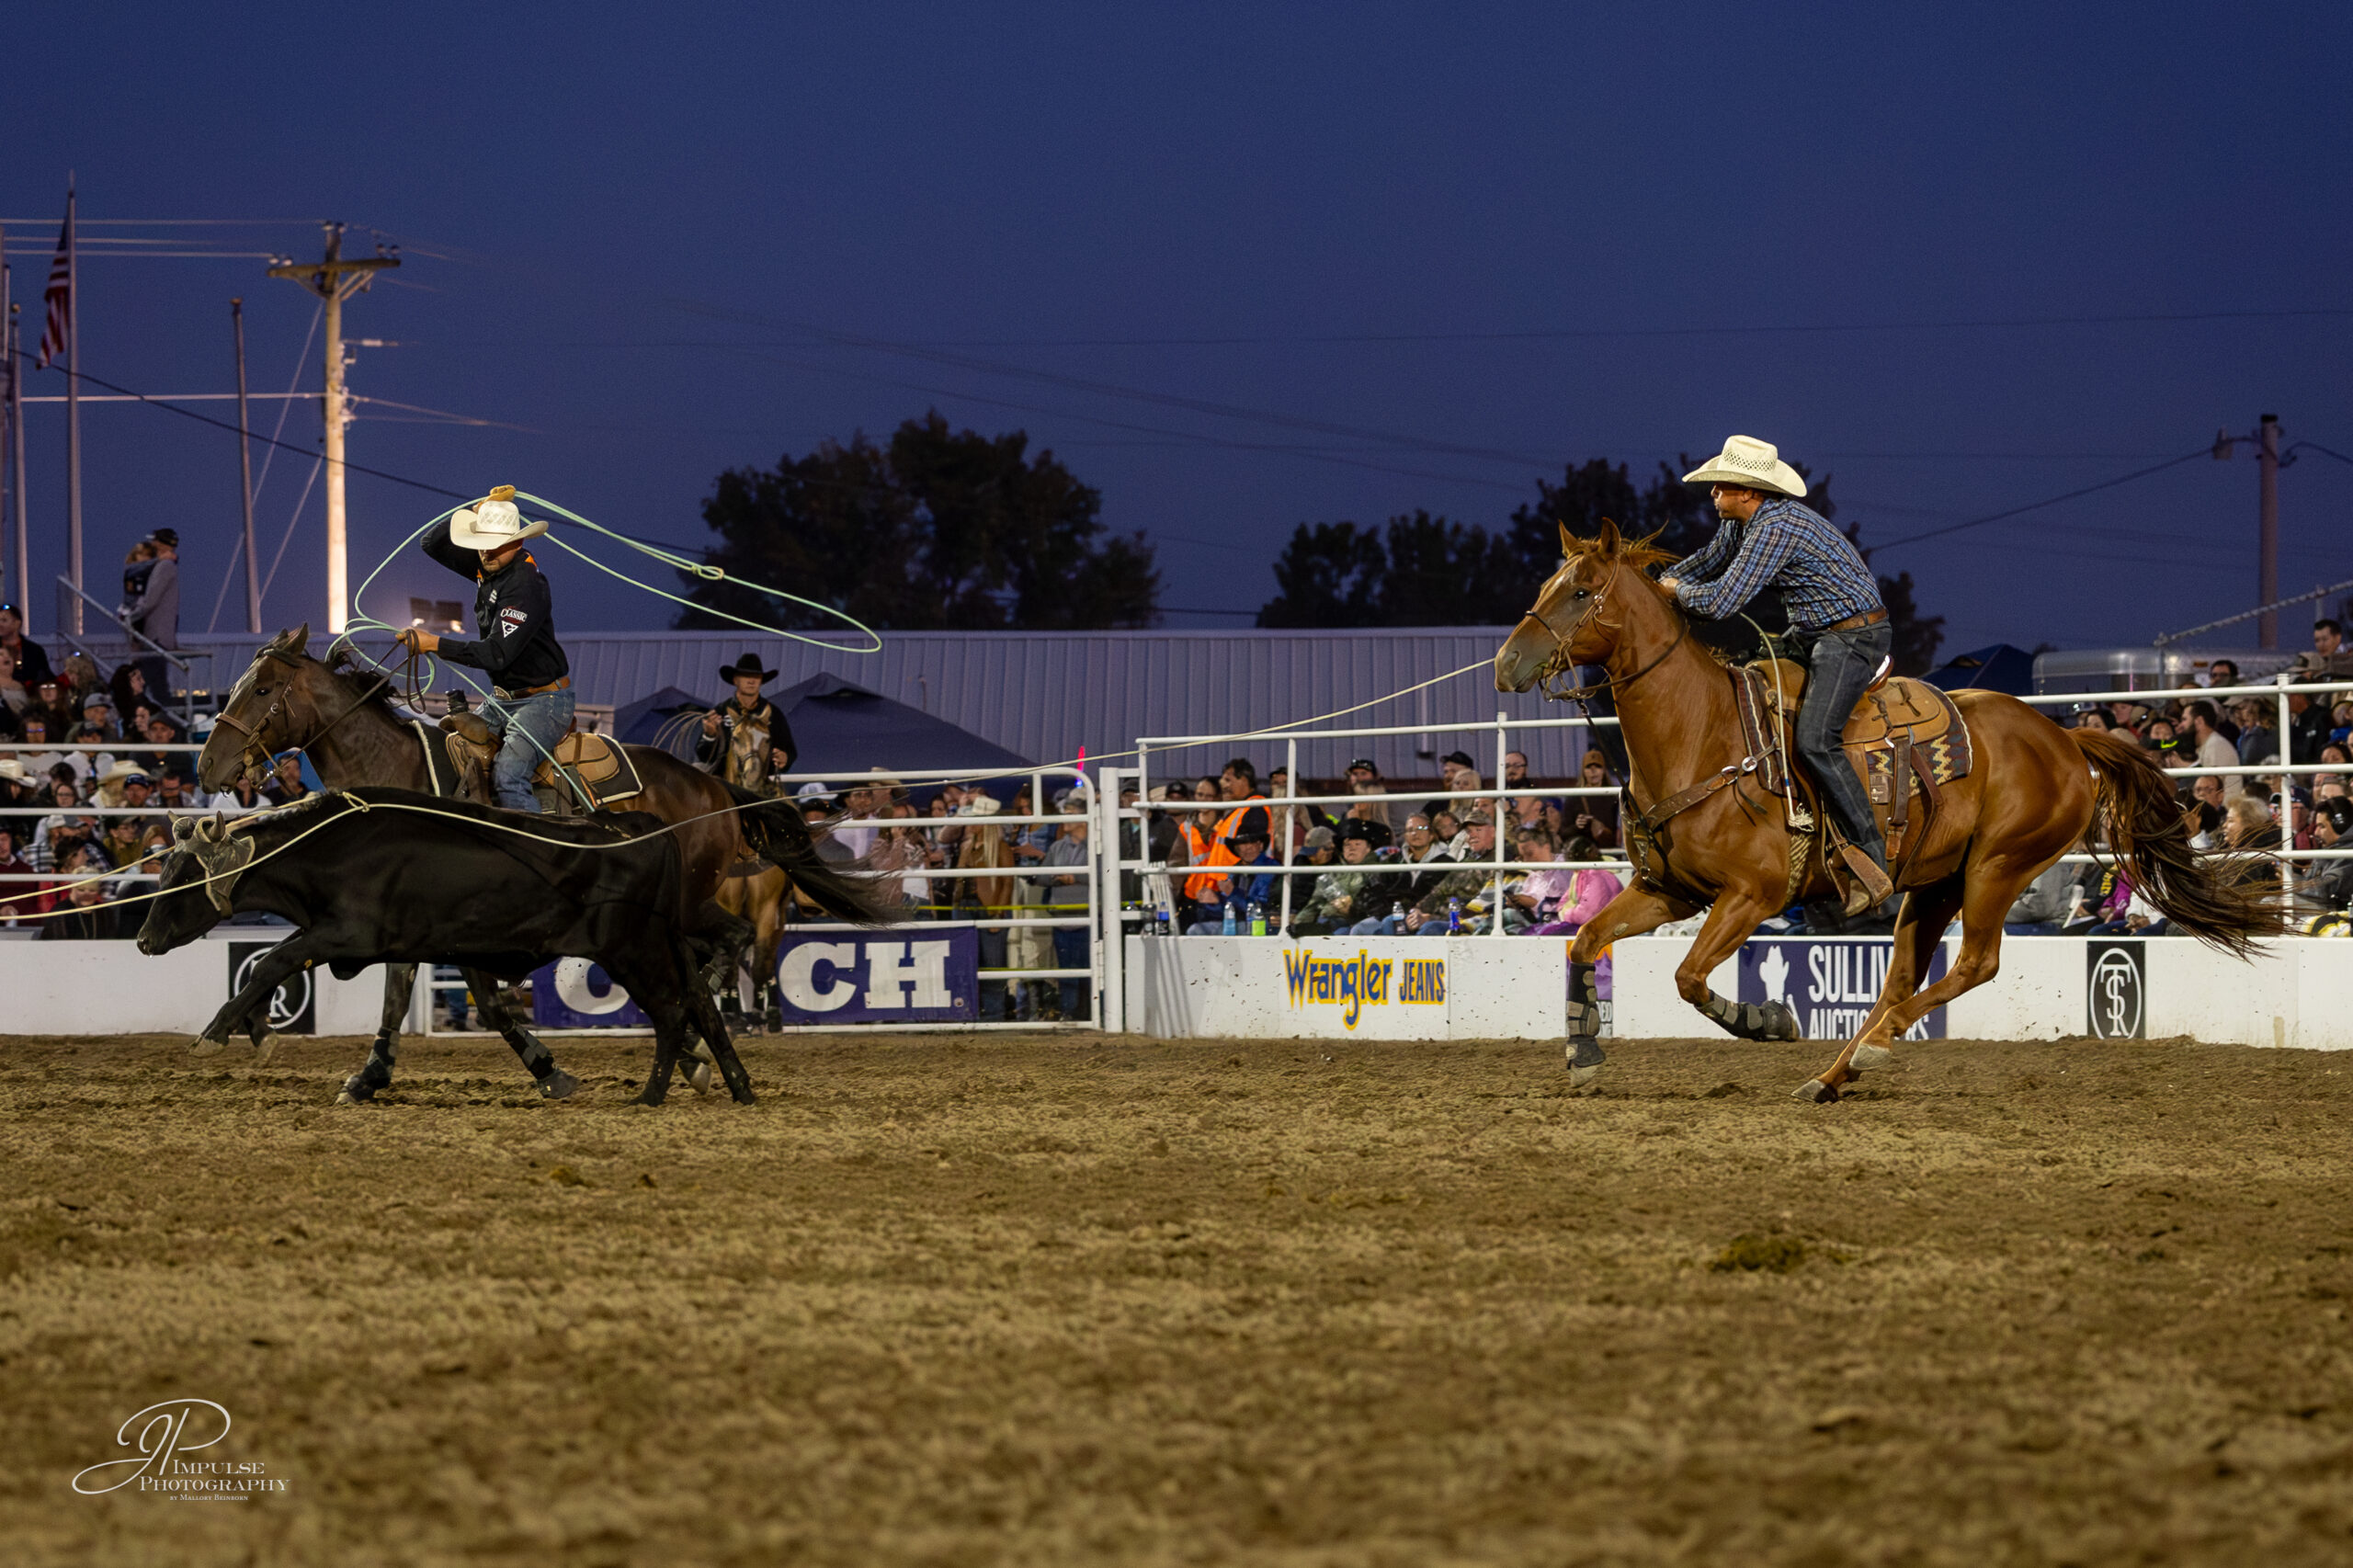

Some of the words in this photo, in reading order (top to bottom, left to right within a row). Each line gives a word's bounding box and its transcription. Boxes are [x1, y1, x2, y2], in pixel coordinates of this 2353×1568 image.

[500, 608, 529, 622] CLASSIC
[1283, 945, 1393, 1031] Wrangler
[1399, 959, 1446, 1006] JEANS
